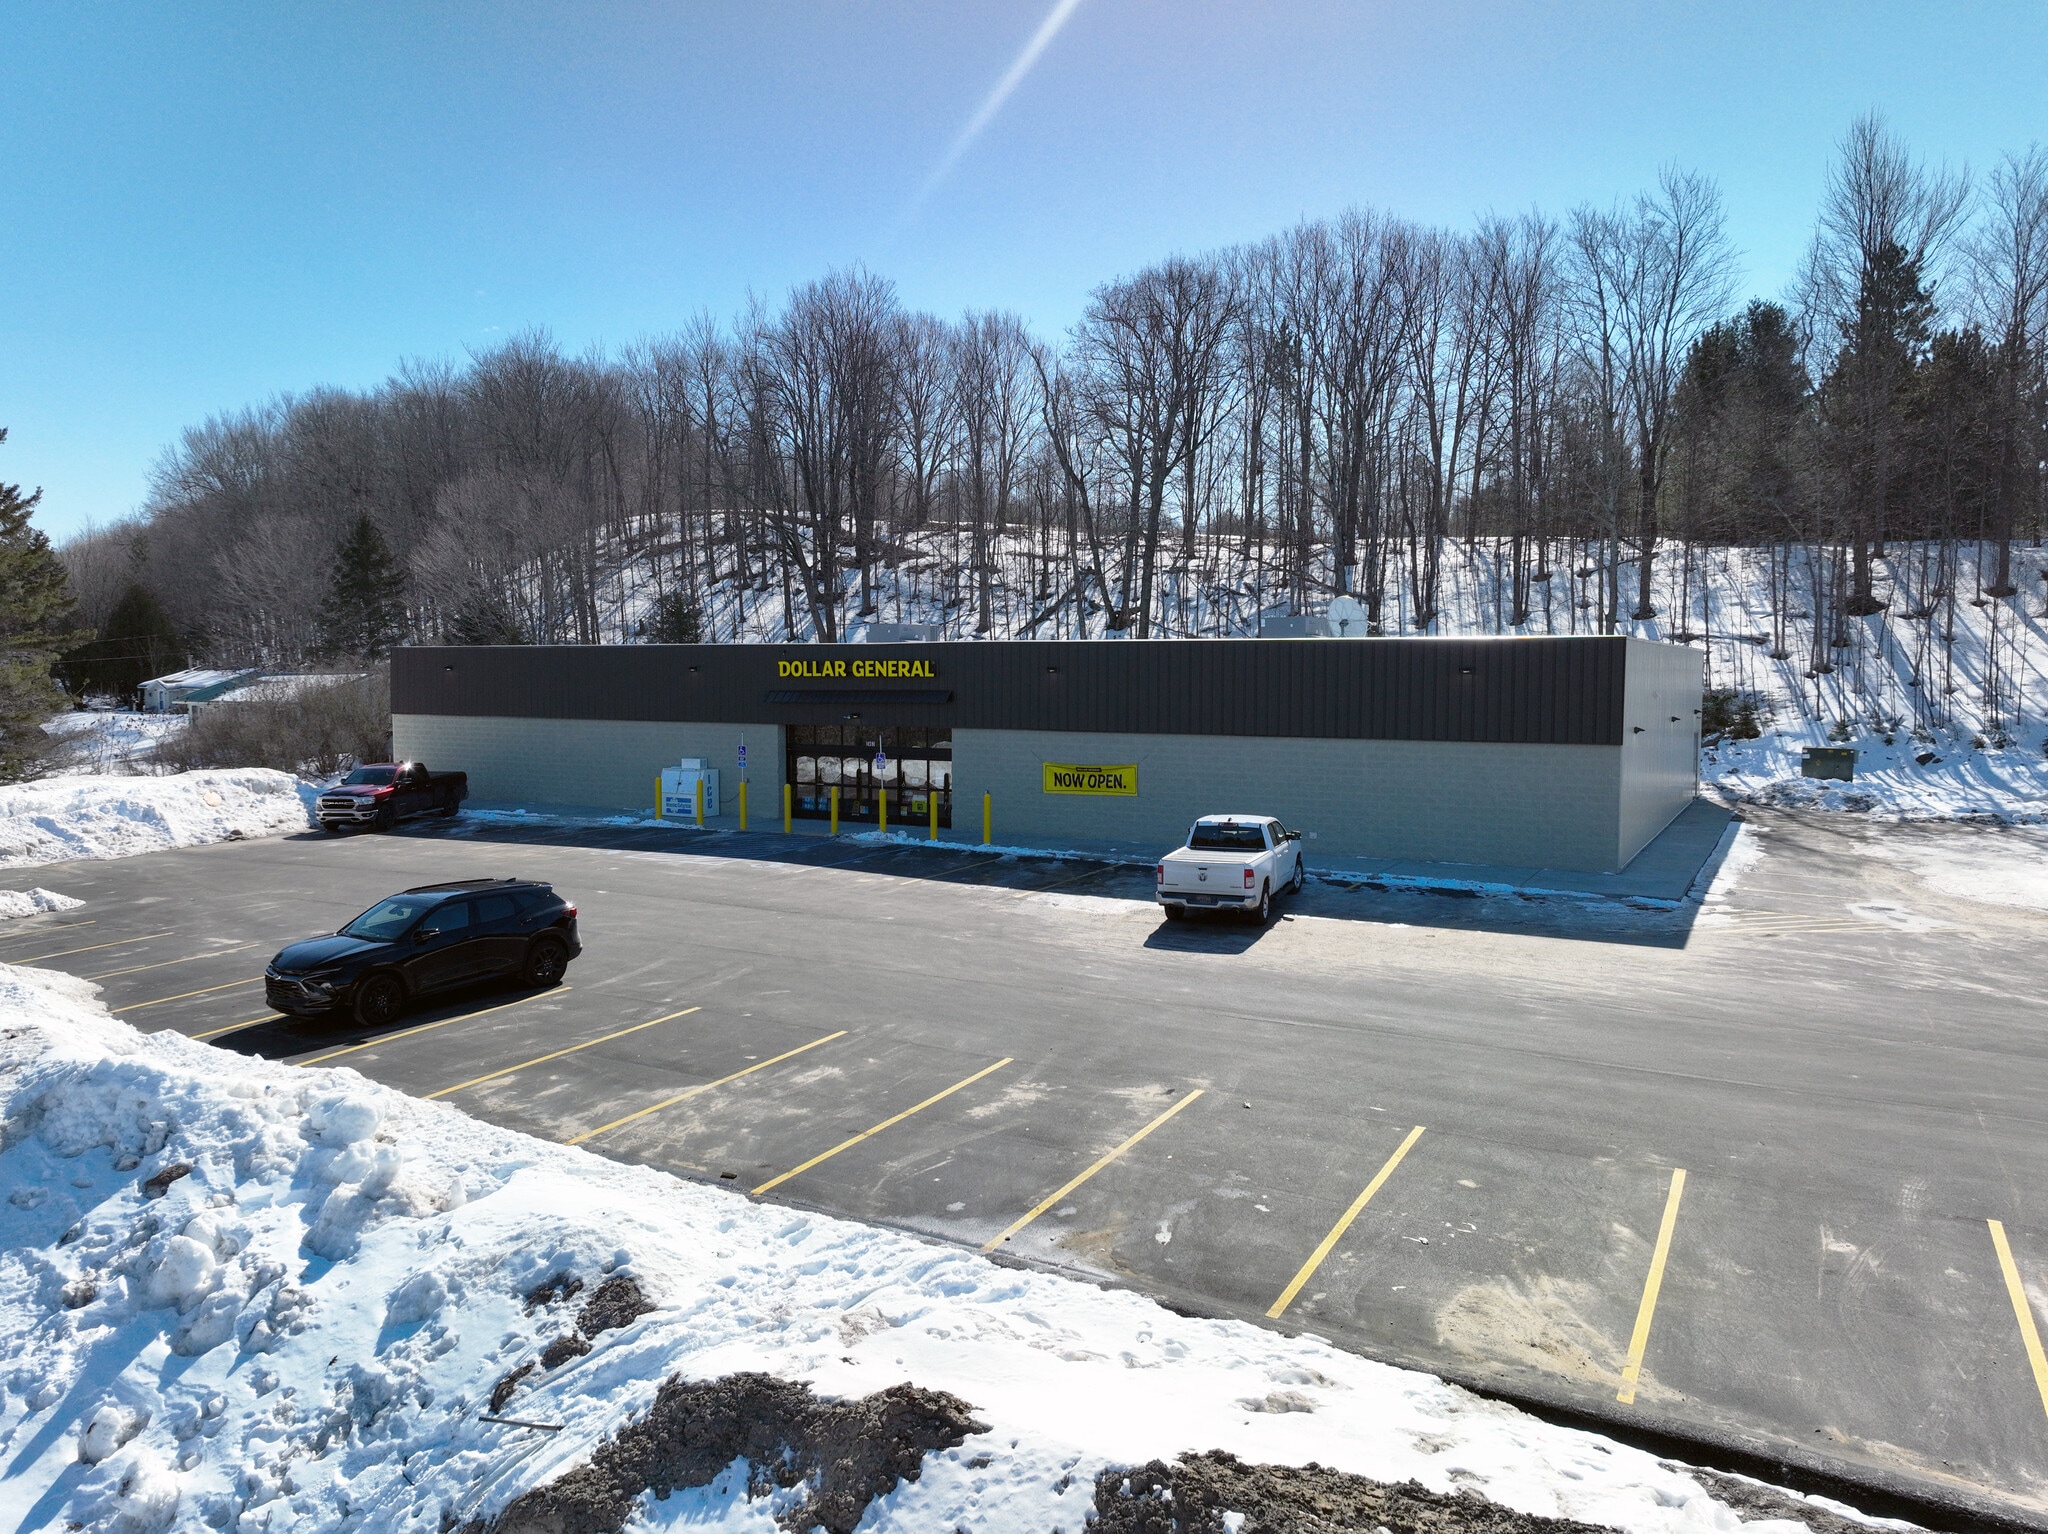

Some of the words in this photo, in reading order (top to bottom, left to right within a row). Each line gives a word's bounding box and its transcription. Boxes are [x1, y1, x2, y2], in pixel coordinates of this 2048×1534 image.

[778, 660, 846, 677] DOLLAR
[851, 660, 935, 677] GENERAL
[1054, 772, 1085, 788] NOW
[1087, 774, 1127, 789] OPEN.
